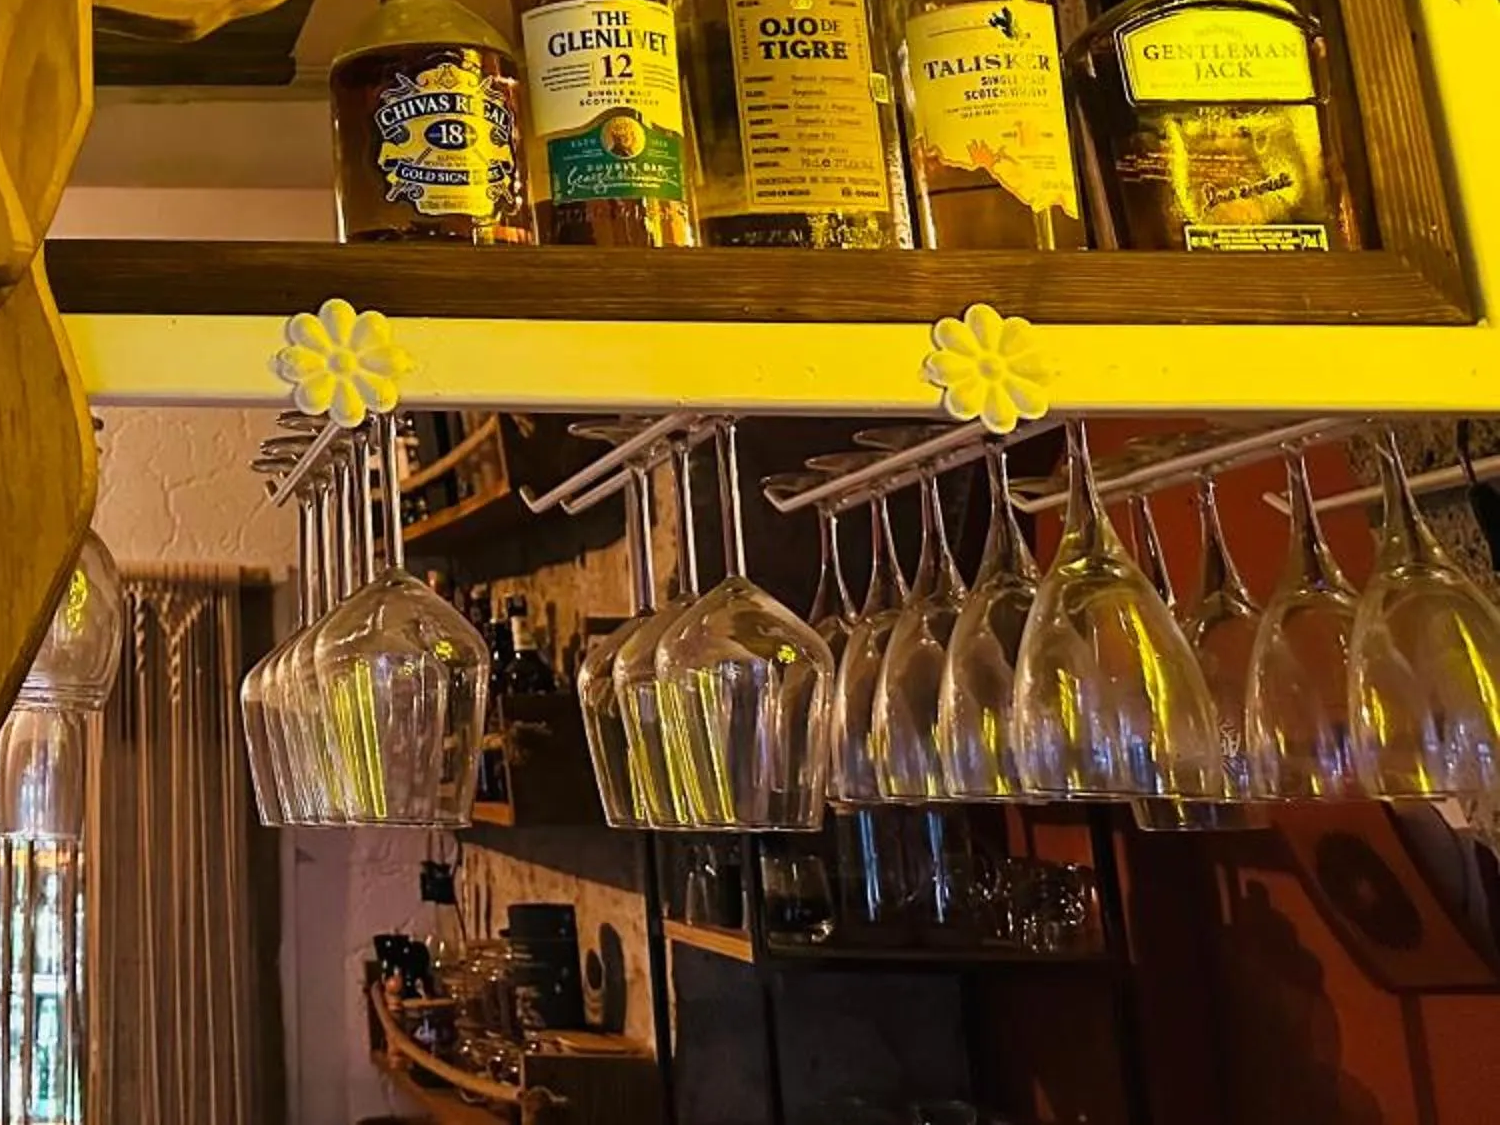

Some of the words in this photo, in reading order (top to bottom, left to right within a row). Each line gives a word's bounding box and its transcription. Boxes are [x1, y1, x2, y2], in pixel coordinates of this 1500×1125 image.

[593, 10, 632, 26] THE
[759, 17, 819, 37] OJO
[548, 29, 668, 57] GLENLIVET
[758, 40, 850, 61] TIGRE
[1143, 43, 1299, 61] GENTLEMAN
[601, 54, 634, 79] 12
[1196, 61, 1254, 82] JACK
[380, 94, 450, 127] CHIVAS
[438, 124, 463, 145] 18
[401, 167, 436, 179] GOLD
